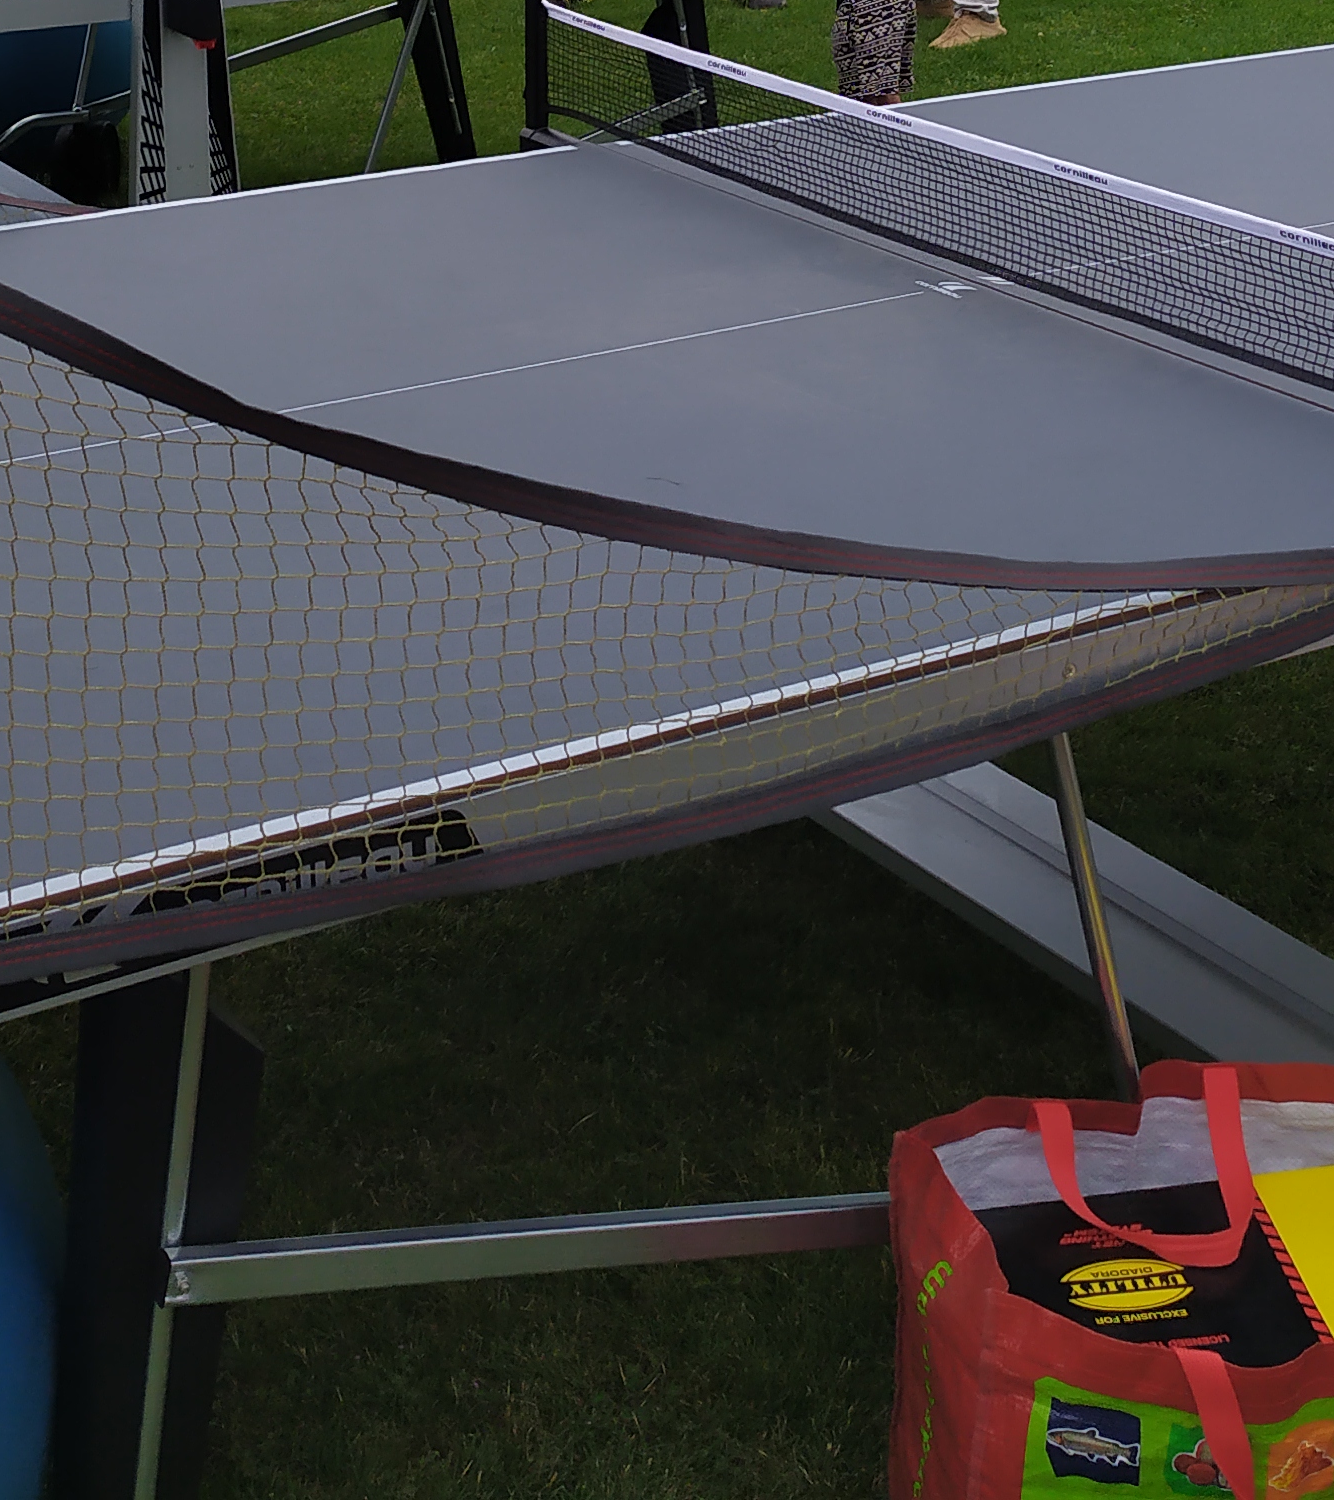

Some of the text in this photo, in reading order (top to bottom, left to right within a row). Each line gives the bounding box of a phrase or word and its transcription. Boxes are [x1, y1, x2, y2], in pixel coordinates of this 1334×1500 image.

[707, 60, 747, 77] cornilleau
[866, 108, 913, 128] cornilleau
[1053, 163, 1109, 186] cornilleau
[1089, 1266, 1153, 1279] DIADORA
[1069, 1272, 1188, 1297] UTILITY
[1095, 1308, 1188, 1326] EXCLUSIVE FOR
